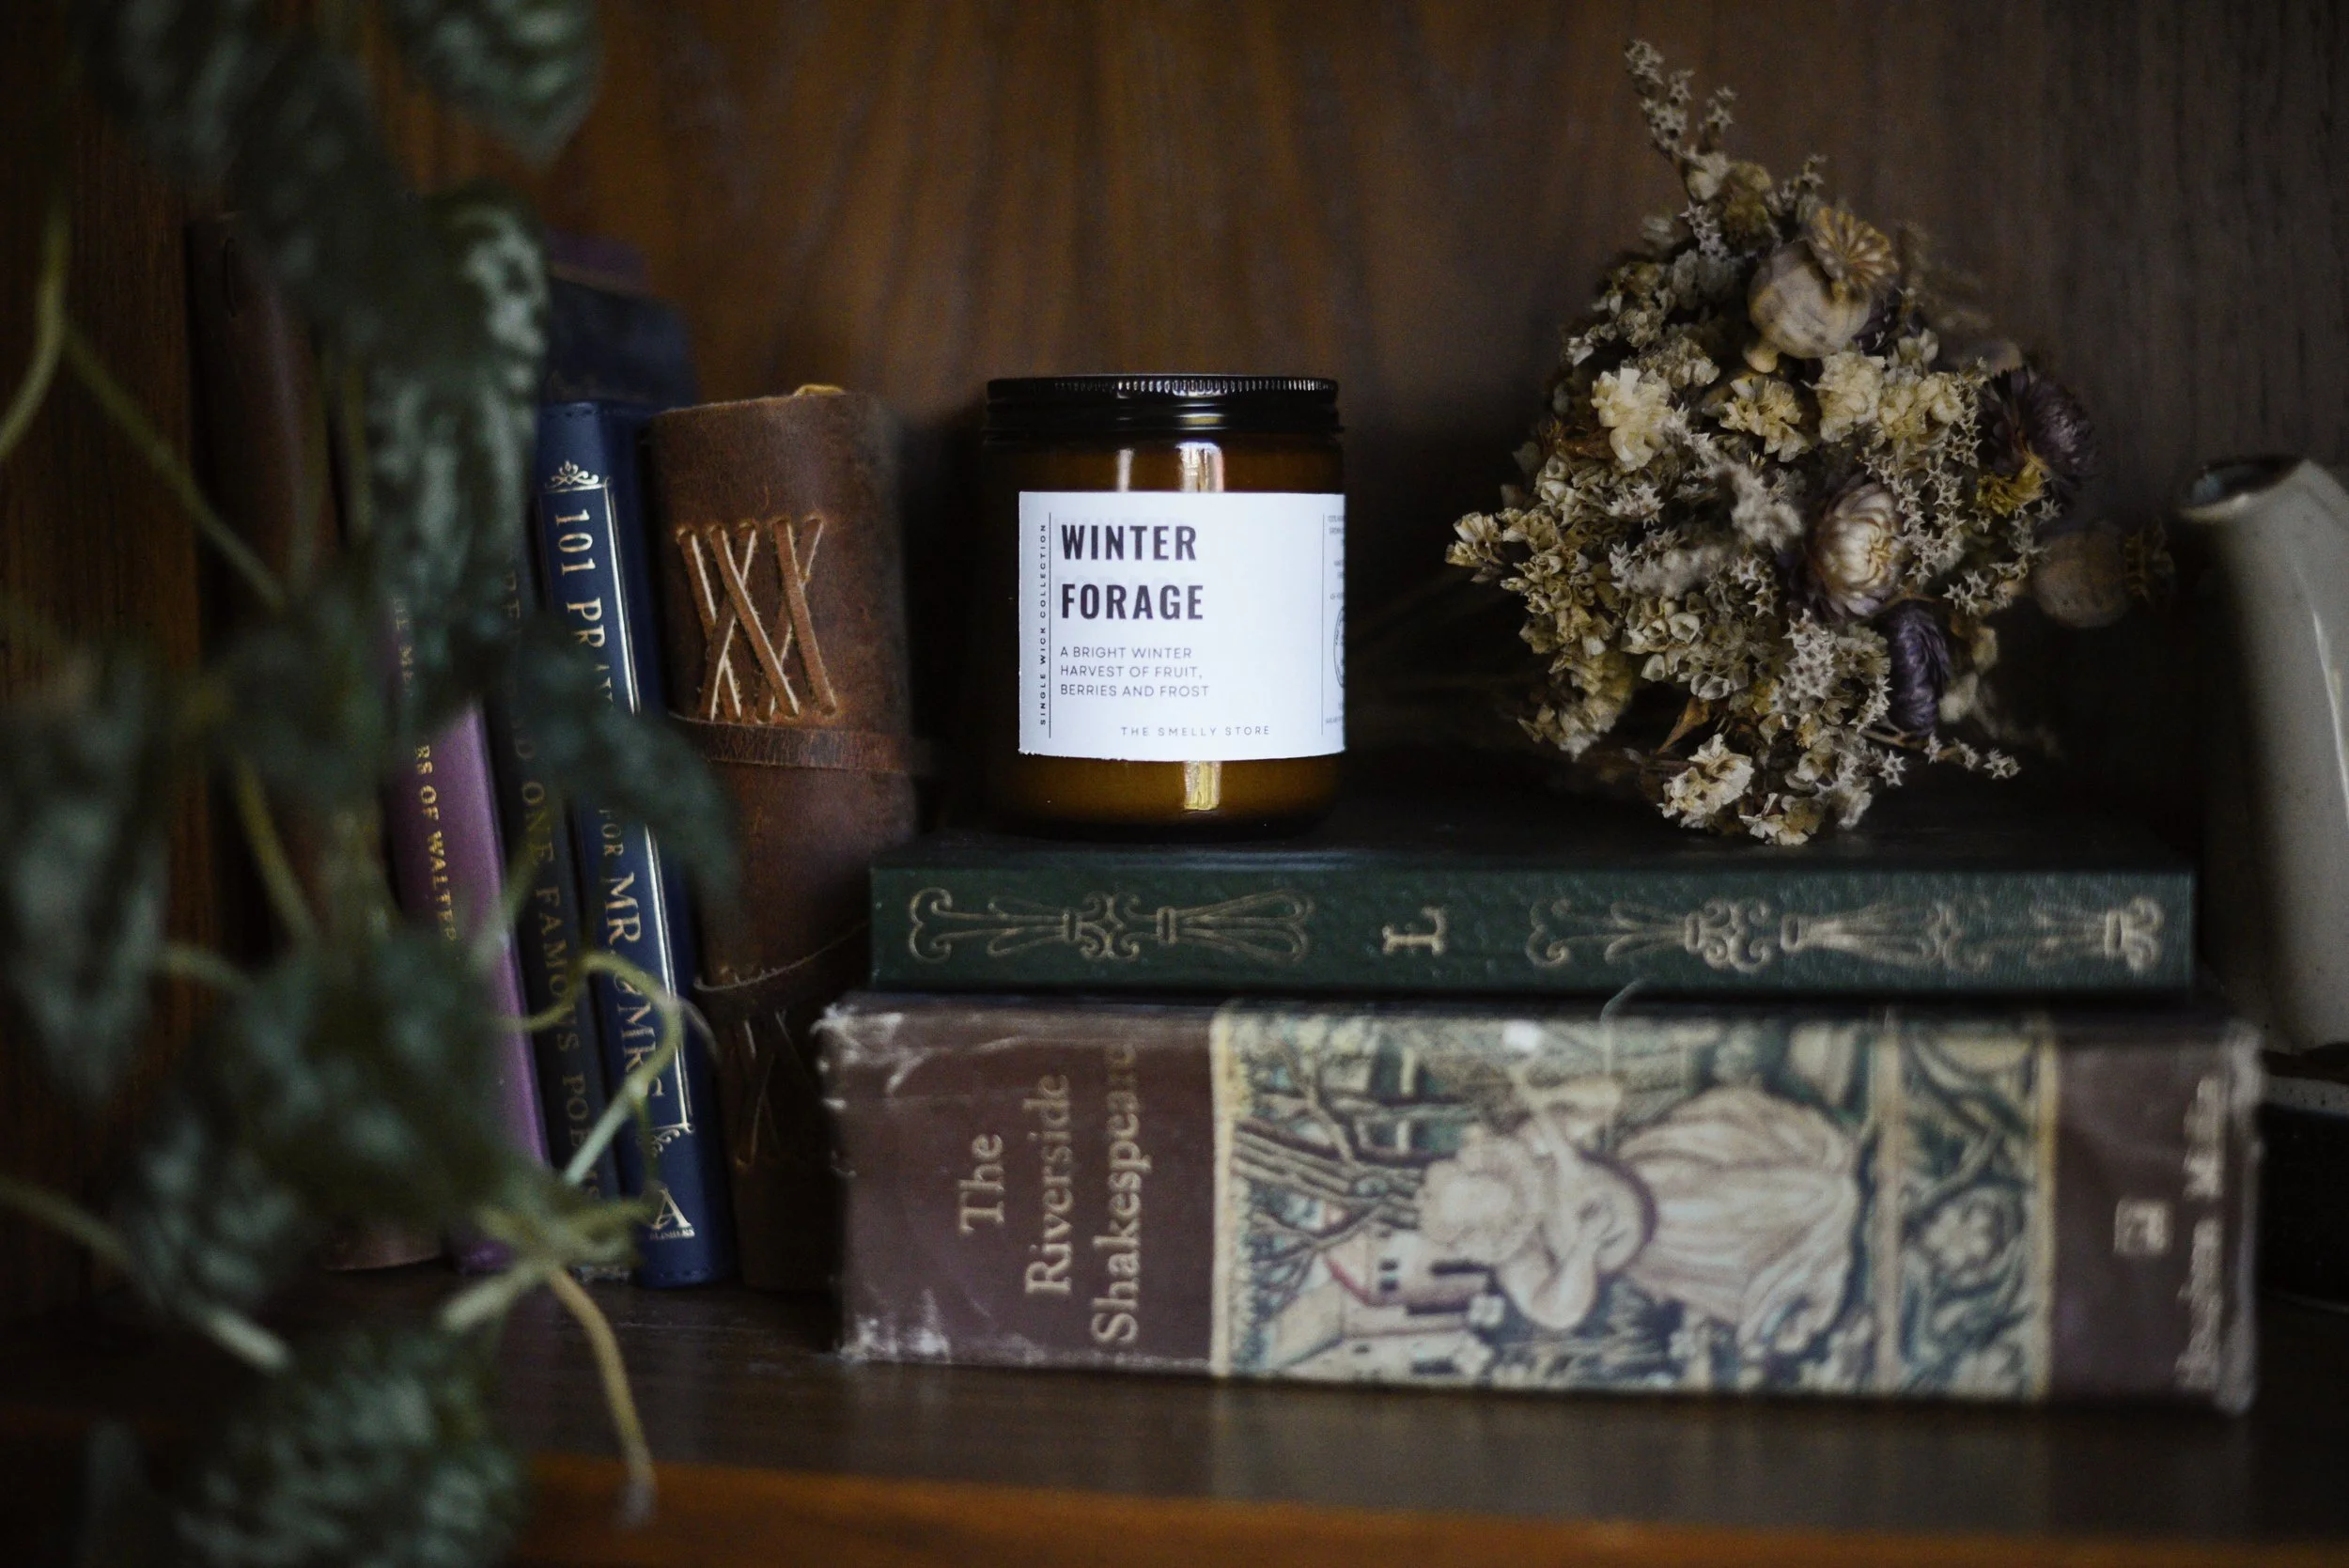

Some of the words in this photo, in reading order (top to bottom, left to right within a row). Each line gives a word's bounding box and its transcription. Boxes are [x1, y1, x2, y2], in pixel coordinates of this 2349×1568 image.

[554, 508, 597, 576] 101
[1061, 524, 1196, 560] WINTER
[1061, 583, 1204, 620] FORAGE
[1060, 646, 1068, 659] A
[1073, 646, 1127, 659] BRIGHT
[1131, 646, 1191, 659] WINTER
[1060, 665, 1123, 677] HARVEST
[1129, 666, 1149, 677] OF
[1155, 666, 1203, 679] FRUIT,
[1060, 684, 1117, 696] BERRIES
[1122, 685, 1154, 696] AND
[1159, 686, 1209, 697] FROST
[1121, 727, 1149, 737] THE
[1158, 727, 1217, 737] SMELLY
[1224, 726, 1270, 737] STORE
[419, 784, 440, 819] OF
[563, 1075, 599, 1200] POES
[958, 1133, 1004, 1235] The
[1022, 1074, 1073, 1296] Riverside
